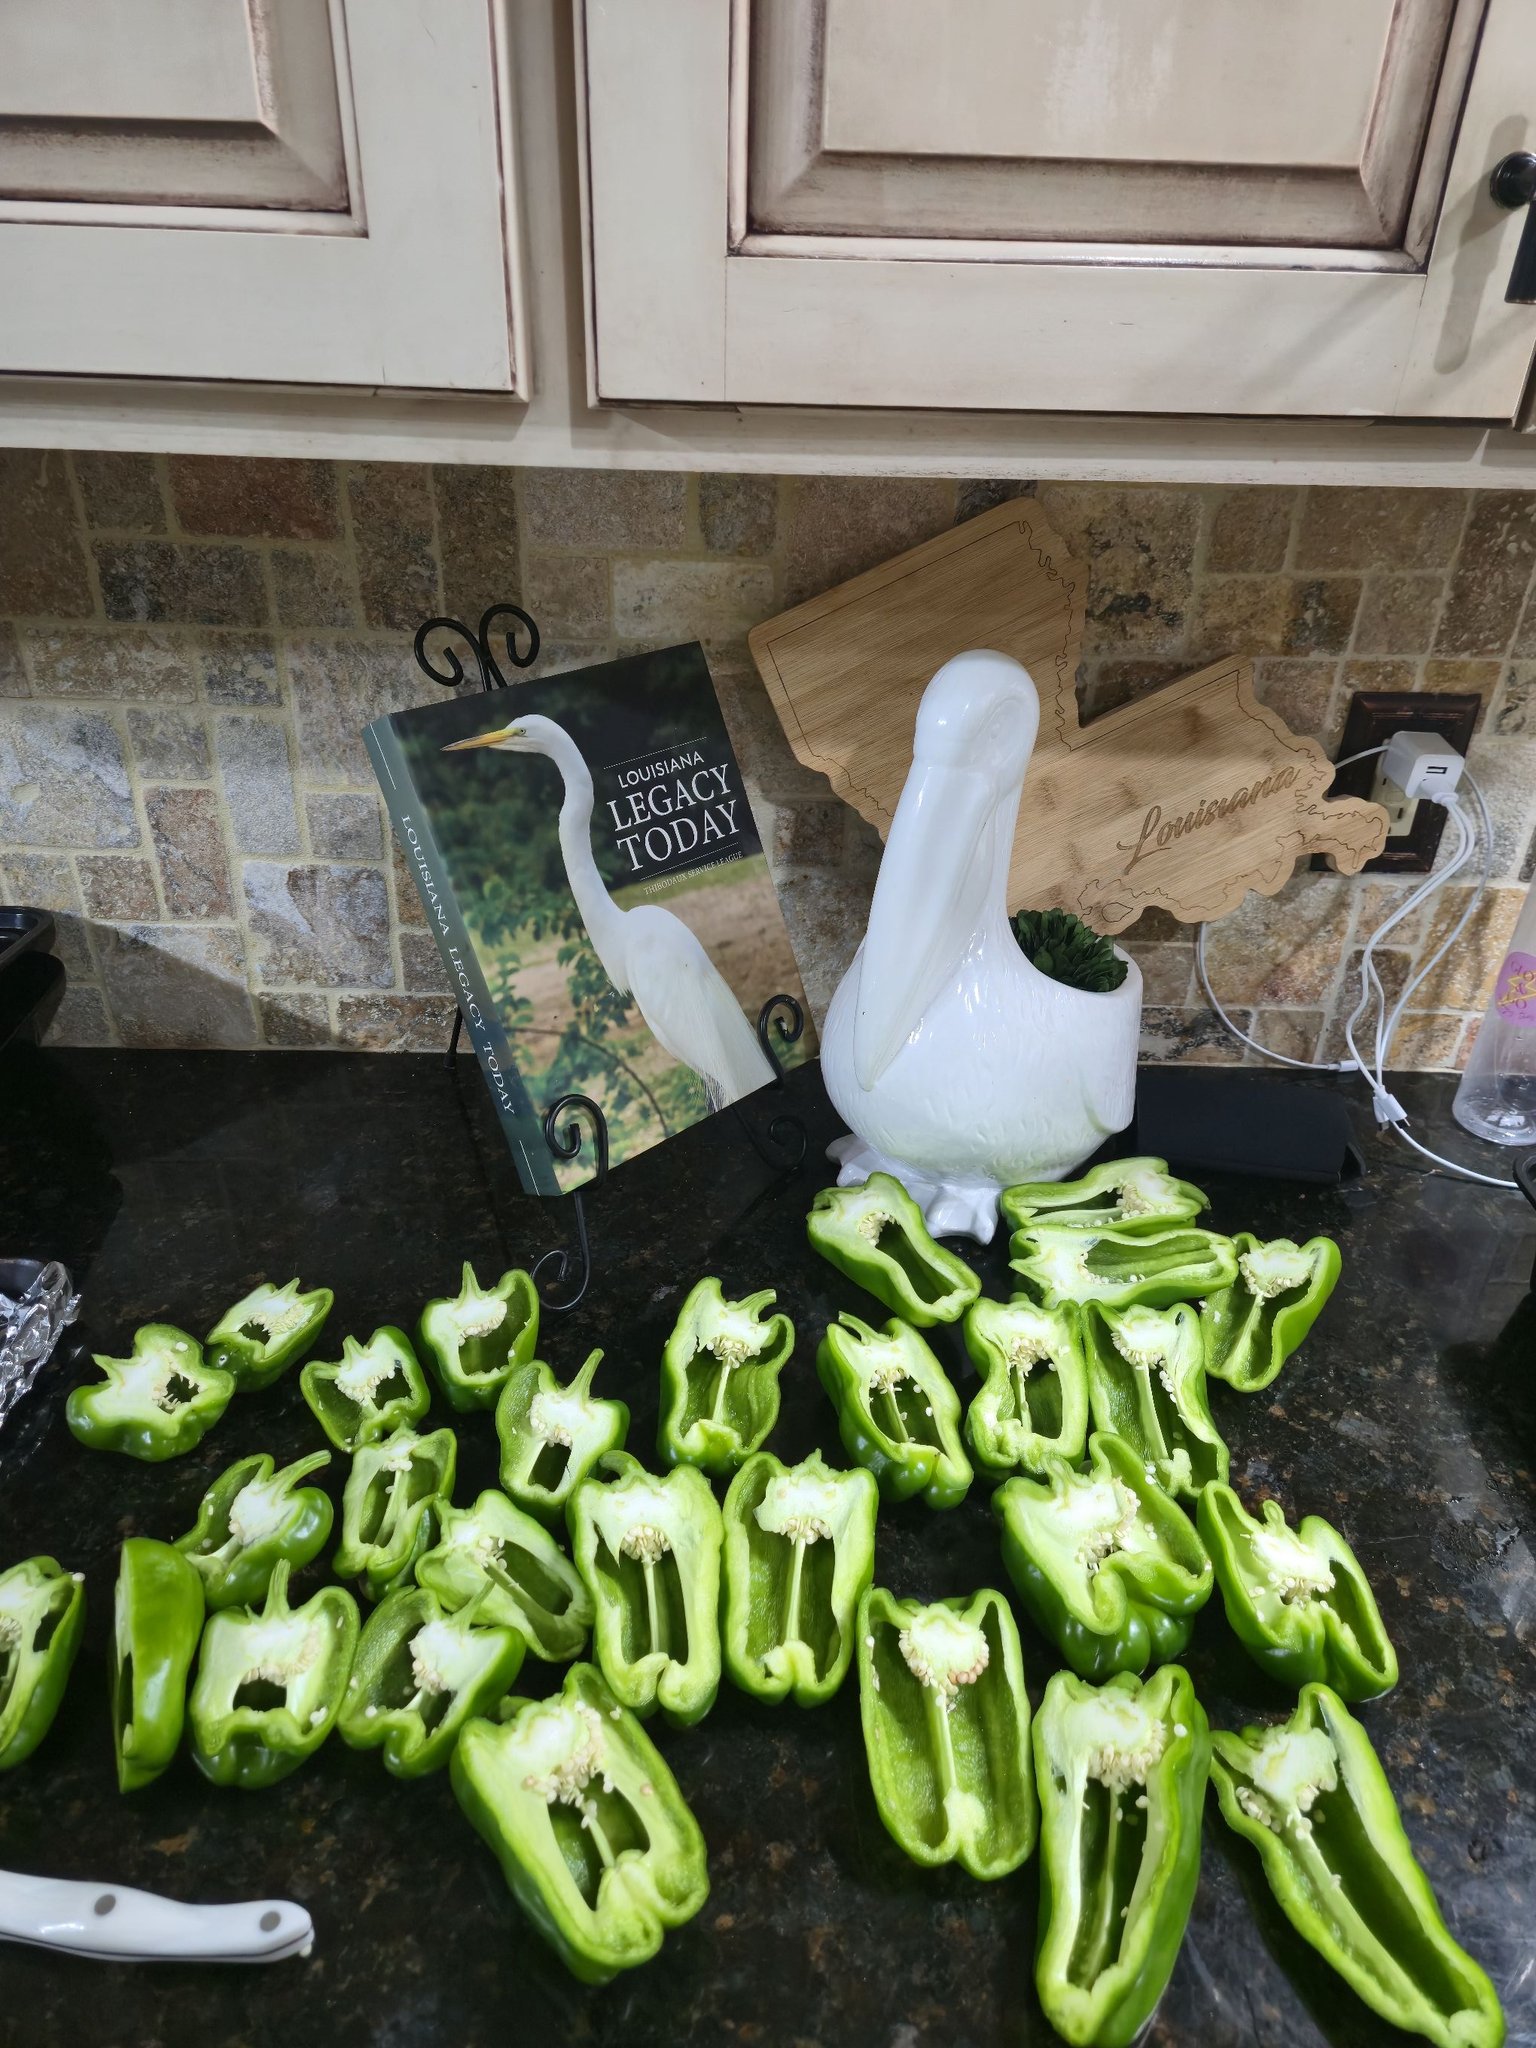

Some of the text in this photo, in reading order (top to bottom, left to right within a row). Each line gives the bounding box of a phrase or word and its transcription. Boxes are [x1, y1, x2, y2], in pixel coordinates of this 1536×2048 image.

[606, 763, 732, 832] LEGACY
[617, 750, 705, 789] LOUISIANA
[616, 799, 740, 871] TODAY
[1116, 766, 1301, 875] Louisiana
[643, 850, 744, 895] THIBODAUX SERVICE LEAGUE
[401, 814, 516, 1114] LOUISIANA LEGACY TODAY
